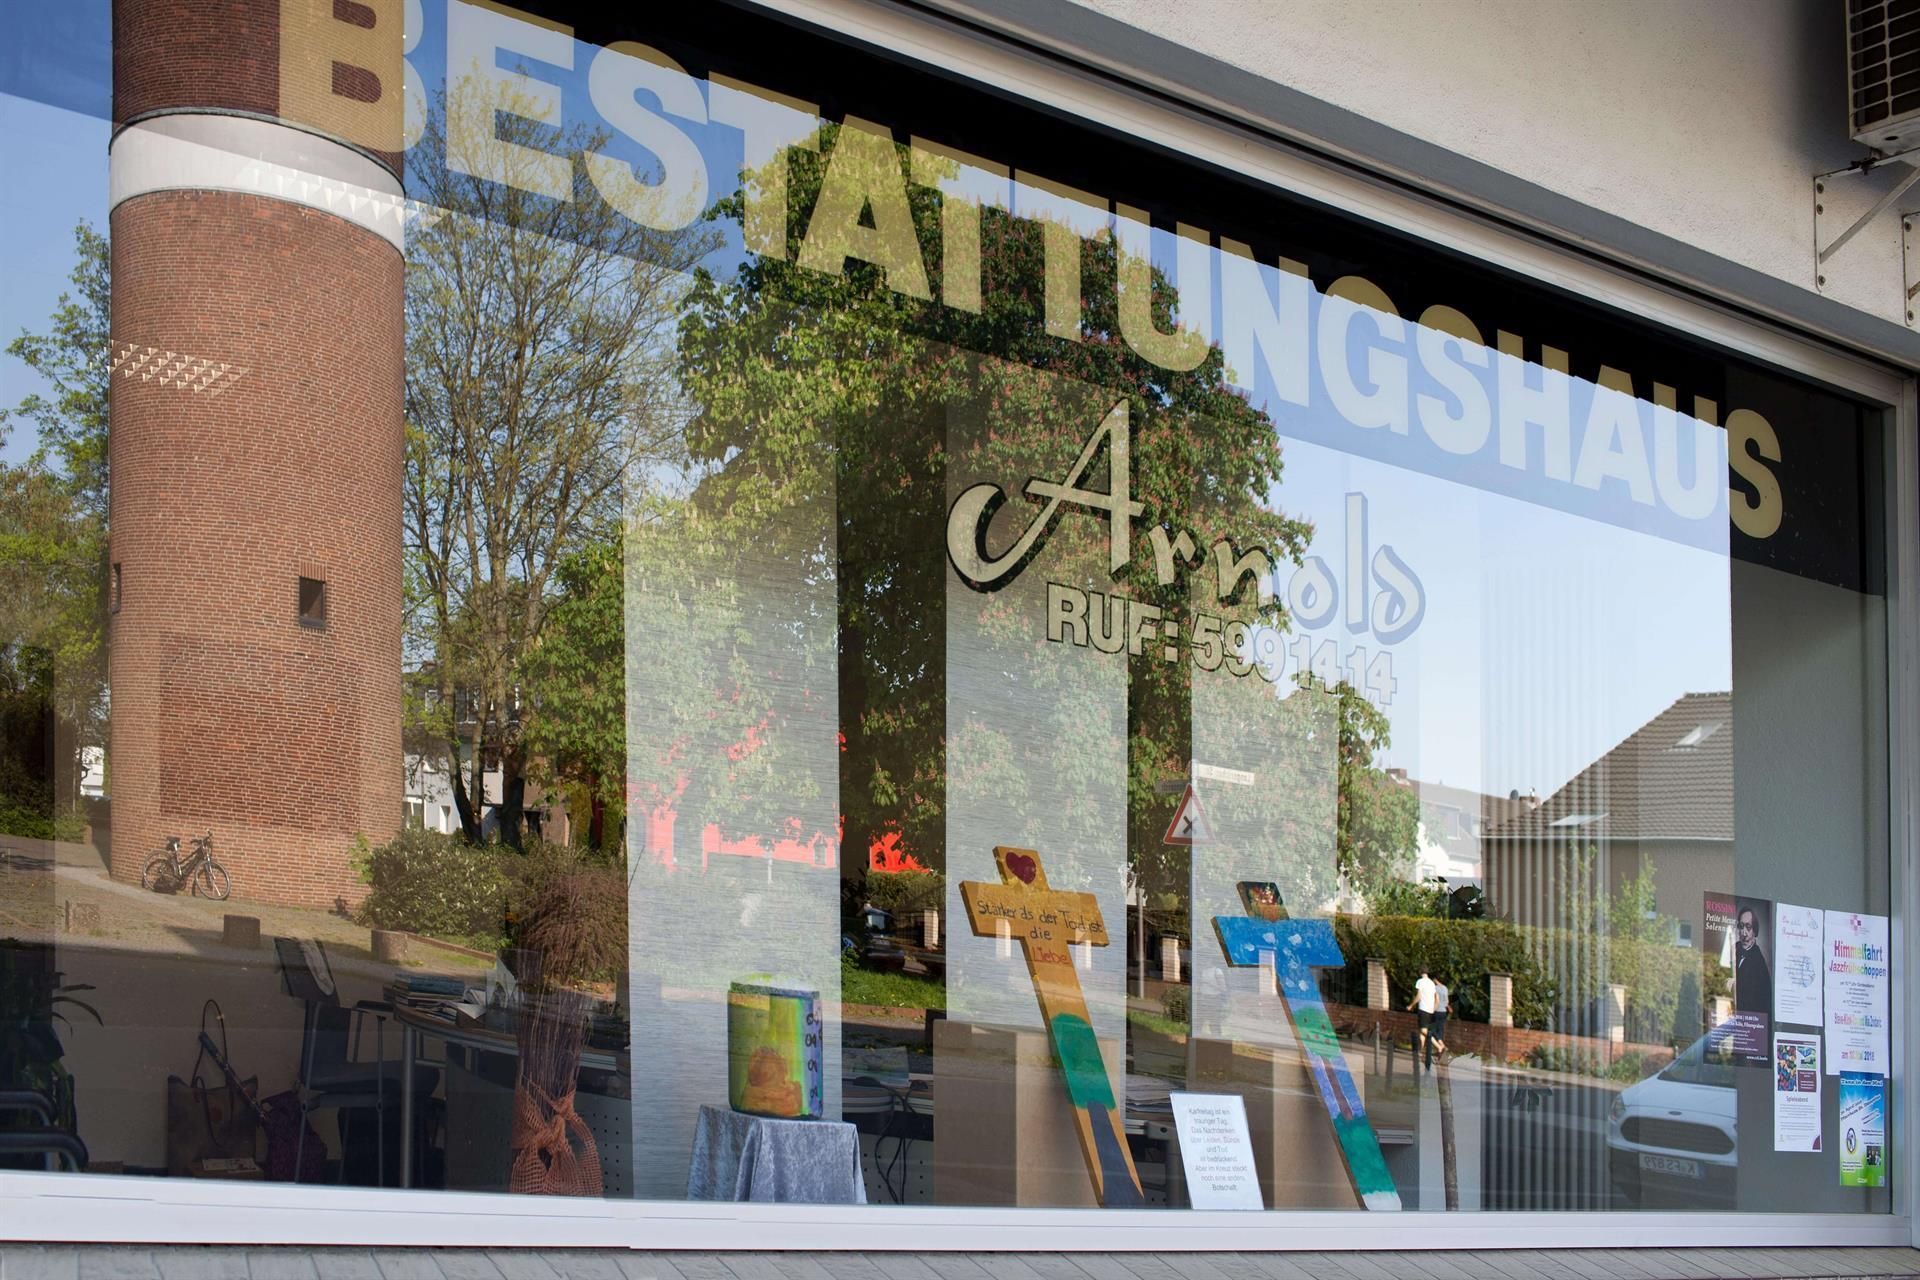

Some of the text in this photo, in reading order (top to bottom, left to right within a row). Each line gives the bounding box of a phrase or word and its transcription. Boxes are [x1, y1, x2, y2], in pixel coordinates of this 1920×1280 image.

[279, 0, 1783, 539] BESTATTUNGSHAUS
[1047, 582, 1179, 663] RUF:
[977, 900, 1016, 919] Stärker
[1039, 910, 1058, 925] der
[1058, 910, 1086, 931] Tod
[1030, 926, 1052, 940] die
[1834, 939, 1883, 962] Himmelfahrt
